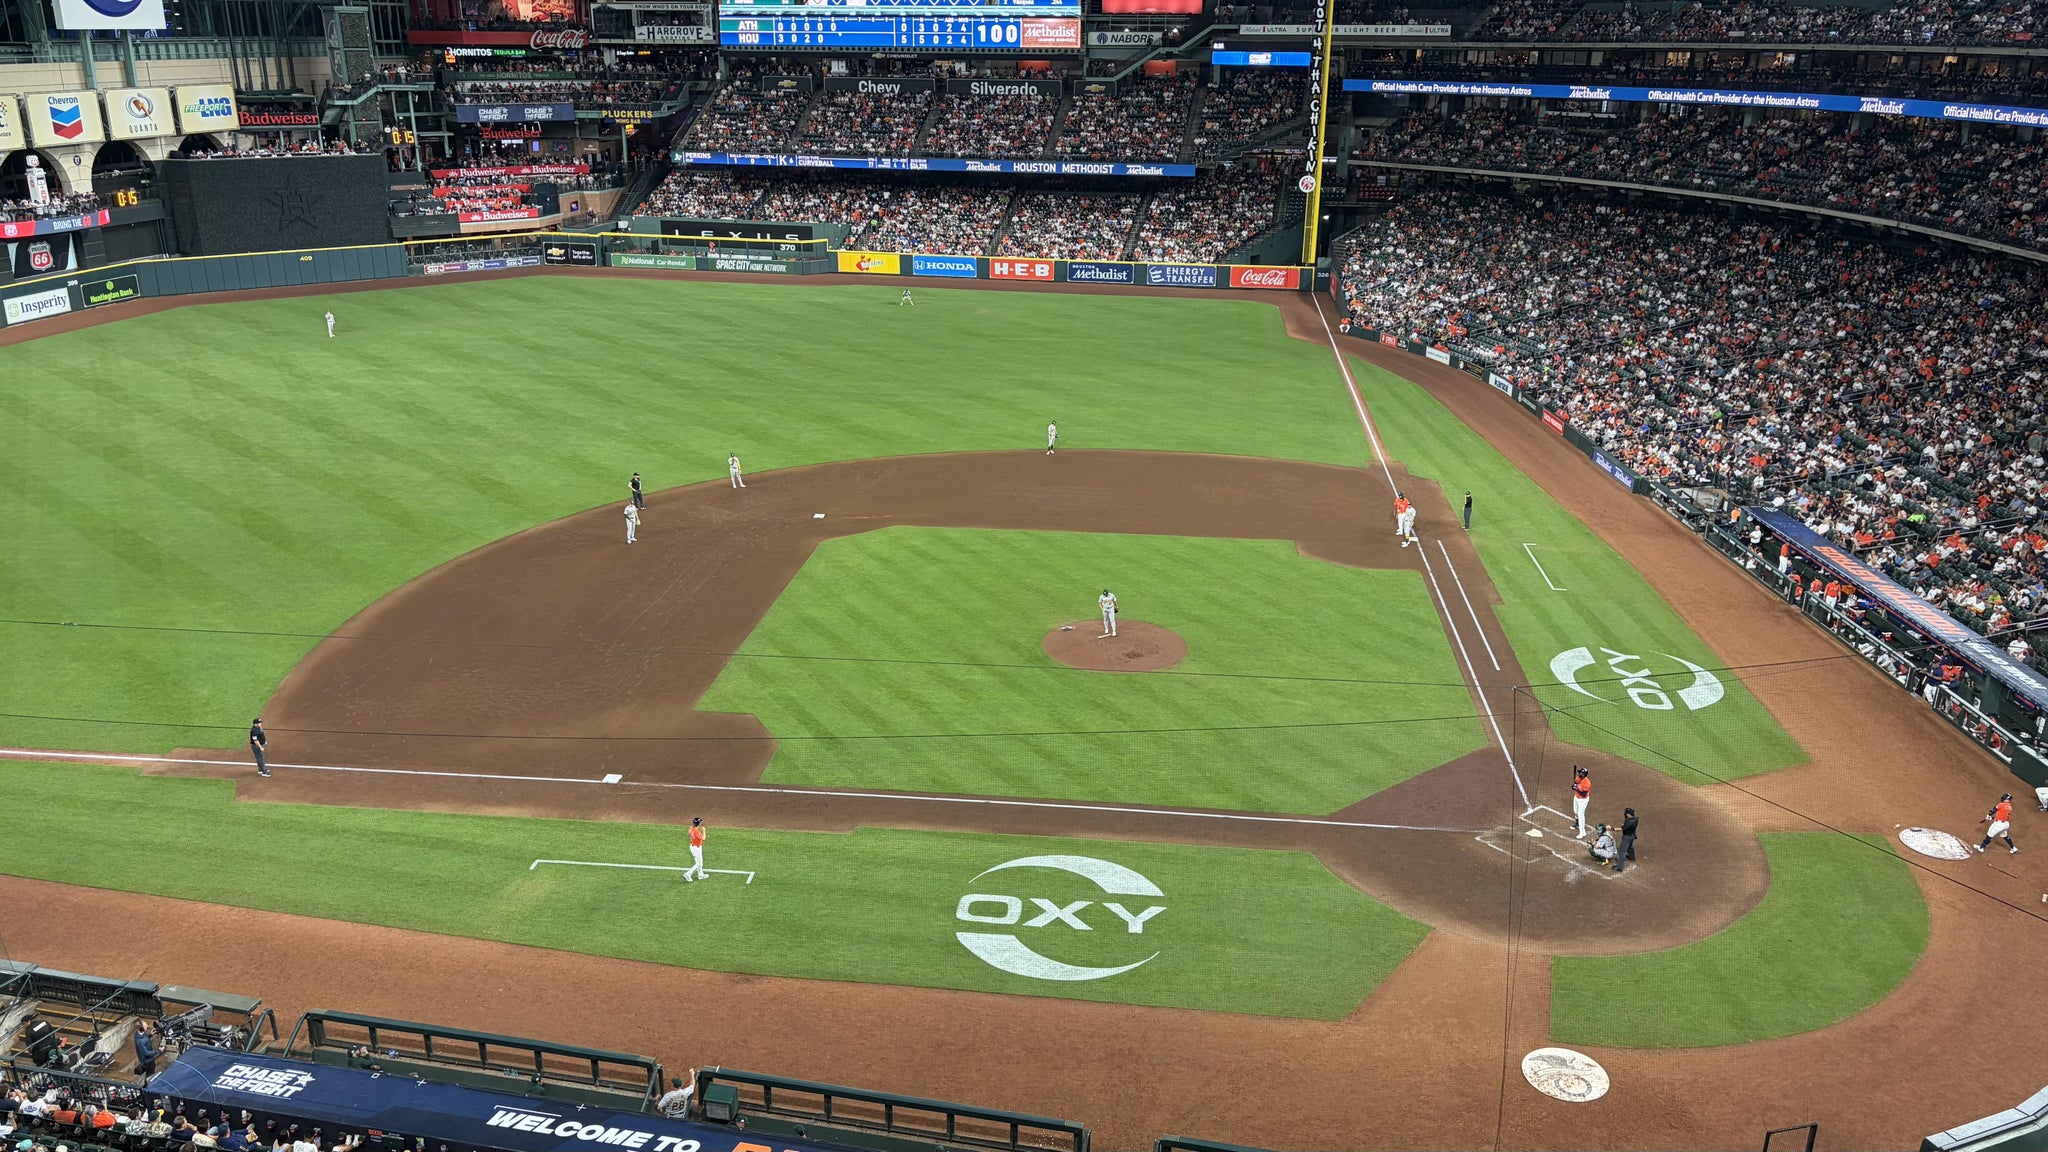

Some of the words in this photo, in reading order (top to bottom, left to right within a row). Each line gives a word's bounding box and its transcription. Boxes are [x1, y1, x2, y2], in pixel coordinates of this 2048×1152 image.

[738, 20, 758, 30] ATH
[778, 22, 784, 30] 0
[791, 22, 796, 31] 0
[804, 22, 810, 31] 0
[818, 22, 823, 31] 0
[830, 23, 836, 31] 0
[901, 23, 907, 32] 0
[919, 24, 924, 32] 3
[933, 24, 938, 32] 0
[946, 24, 952, 32] 2
[960, 24, 966, 32] 4
[1024, 26, 1076, 36] Methodist
[530, 29, 587, 49] Coca-Cola
[647, 27, 704, 40] HARGROVE
[739, 34, 759, 43] HOU
[778, 34, 784, 42] 3
[792, 34, 797, 42] 0
[804, 34, 810, 43] 2
[818, 34, 824, 44] 0
[902, 35, 907, 44] 5
[920, 36, 925, 44] 5
[933, 36, 939, 44] 0
[946, 36, 952, 44] 2
[960, 36, 966, 44] 4
[1110, 34, 1154, 43] NABORS
[1312, 37, 1322, 49] 4
[450, 48, 492, 56] HORNITOS
[1310, 56, 1322, 94] THA
[858, 80, 900, 94] Chevy
[970, 82, 1038, 96] Silverado
[1372, 82, 1396, 90] Official
[1396, 83, 1417, 91] Health
[1434, 84, 1460, 92] Provider
[1482, 86, 1510, 94] Houston
[1510, 86, 1532, 95] Astros
[1570, 88, 1610, 98] Methodist
[48, 96, 78, 106] Chevron
[1648, 91, 1672, 100] Official
[1674, 92, 1696, 101] Health
[1697, 92, 1713, 102] Care
[1714, 93, 1742, 103] Provider
[1742, 94, 1752, 104] for
[1754, 95, 1764, 104] the
[1766, 95, 1795, 106] Houston
[1796, 96, 1818, 106] Astros
[184, 104, 226, 113] FREEPORT
[199, 97, 232, 118] LNG
[1860, 100, 1904, 114] Methodist
[239, 112, 319, 126] Budweiser
[1944, 106, 1968, 117] Official
[1970, 108, 1993, 120] Health
[1994, 110, 2010, 121] Care
[2011, 111, 2039, 124] Provider
[129, 123, 158, 134] QUANTA
[482, 128, 542, 138] Budweiser
[392, 130, 414, 144] 0:15
[1306, 100, 1320, 172] CHIKIN
[780, 156, 787, 165] K
[460, 168, 506, 177] Budweiser
[532, 166, 576, 174] Budweiser
[1014, 162, 1056, 172] HOUSTON
[1062, 164, 1114, 174] METHODIST
[1126, 166, 1164, 175] Methodist
[118, 191, 138, 207] 0:15
[483, 211, 530, 220] Budweiser
[53, 220, 72, 230] BRING
[72, 218, 82, 228] THE
[32, 245, 48, 253] PHILLIPS
[34, 253, 48, 264] 66
[628, 257, 654, 266] National
[716, 260, 736, 270] SPACE
[736, 260, 750, 270] CITY
[926, 262, 974, 271] HONDA
[994, 263, 1050, 276] H-E-B
[1073, 268, 1128, 280] Methodist
[1166, 267, 1204, 276] ENERGY
[1166, 275, 1214, 284] TRANSFER
[1241, 270, 1286, 286] Coca-Cola
[90, 290, 119, 303] Huntington
[120, 288, 134, 297] Bank
[20, 294, 68, 313] Insperity
[1600, 646, 1674, 710] OXY
[956, 894, 1168, 934] OXY
[224, 1064, 298, 1085] CHASE
[216, 1074, 248, 1087] THE
[238, 1080, 304, 1098] FIGHT
[672, 1100, 684, 1110] 28
[486, 1110, 654, 1147] WELCOME
[655, 1135, 701, 1152] TO
